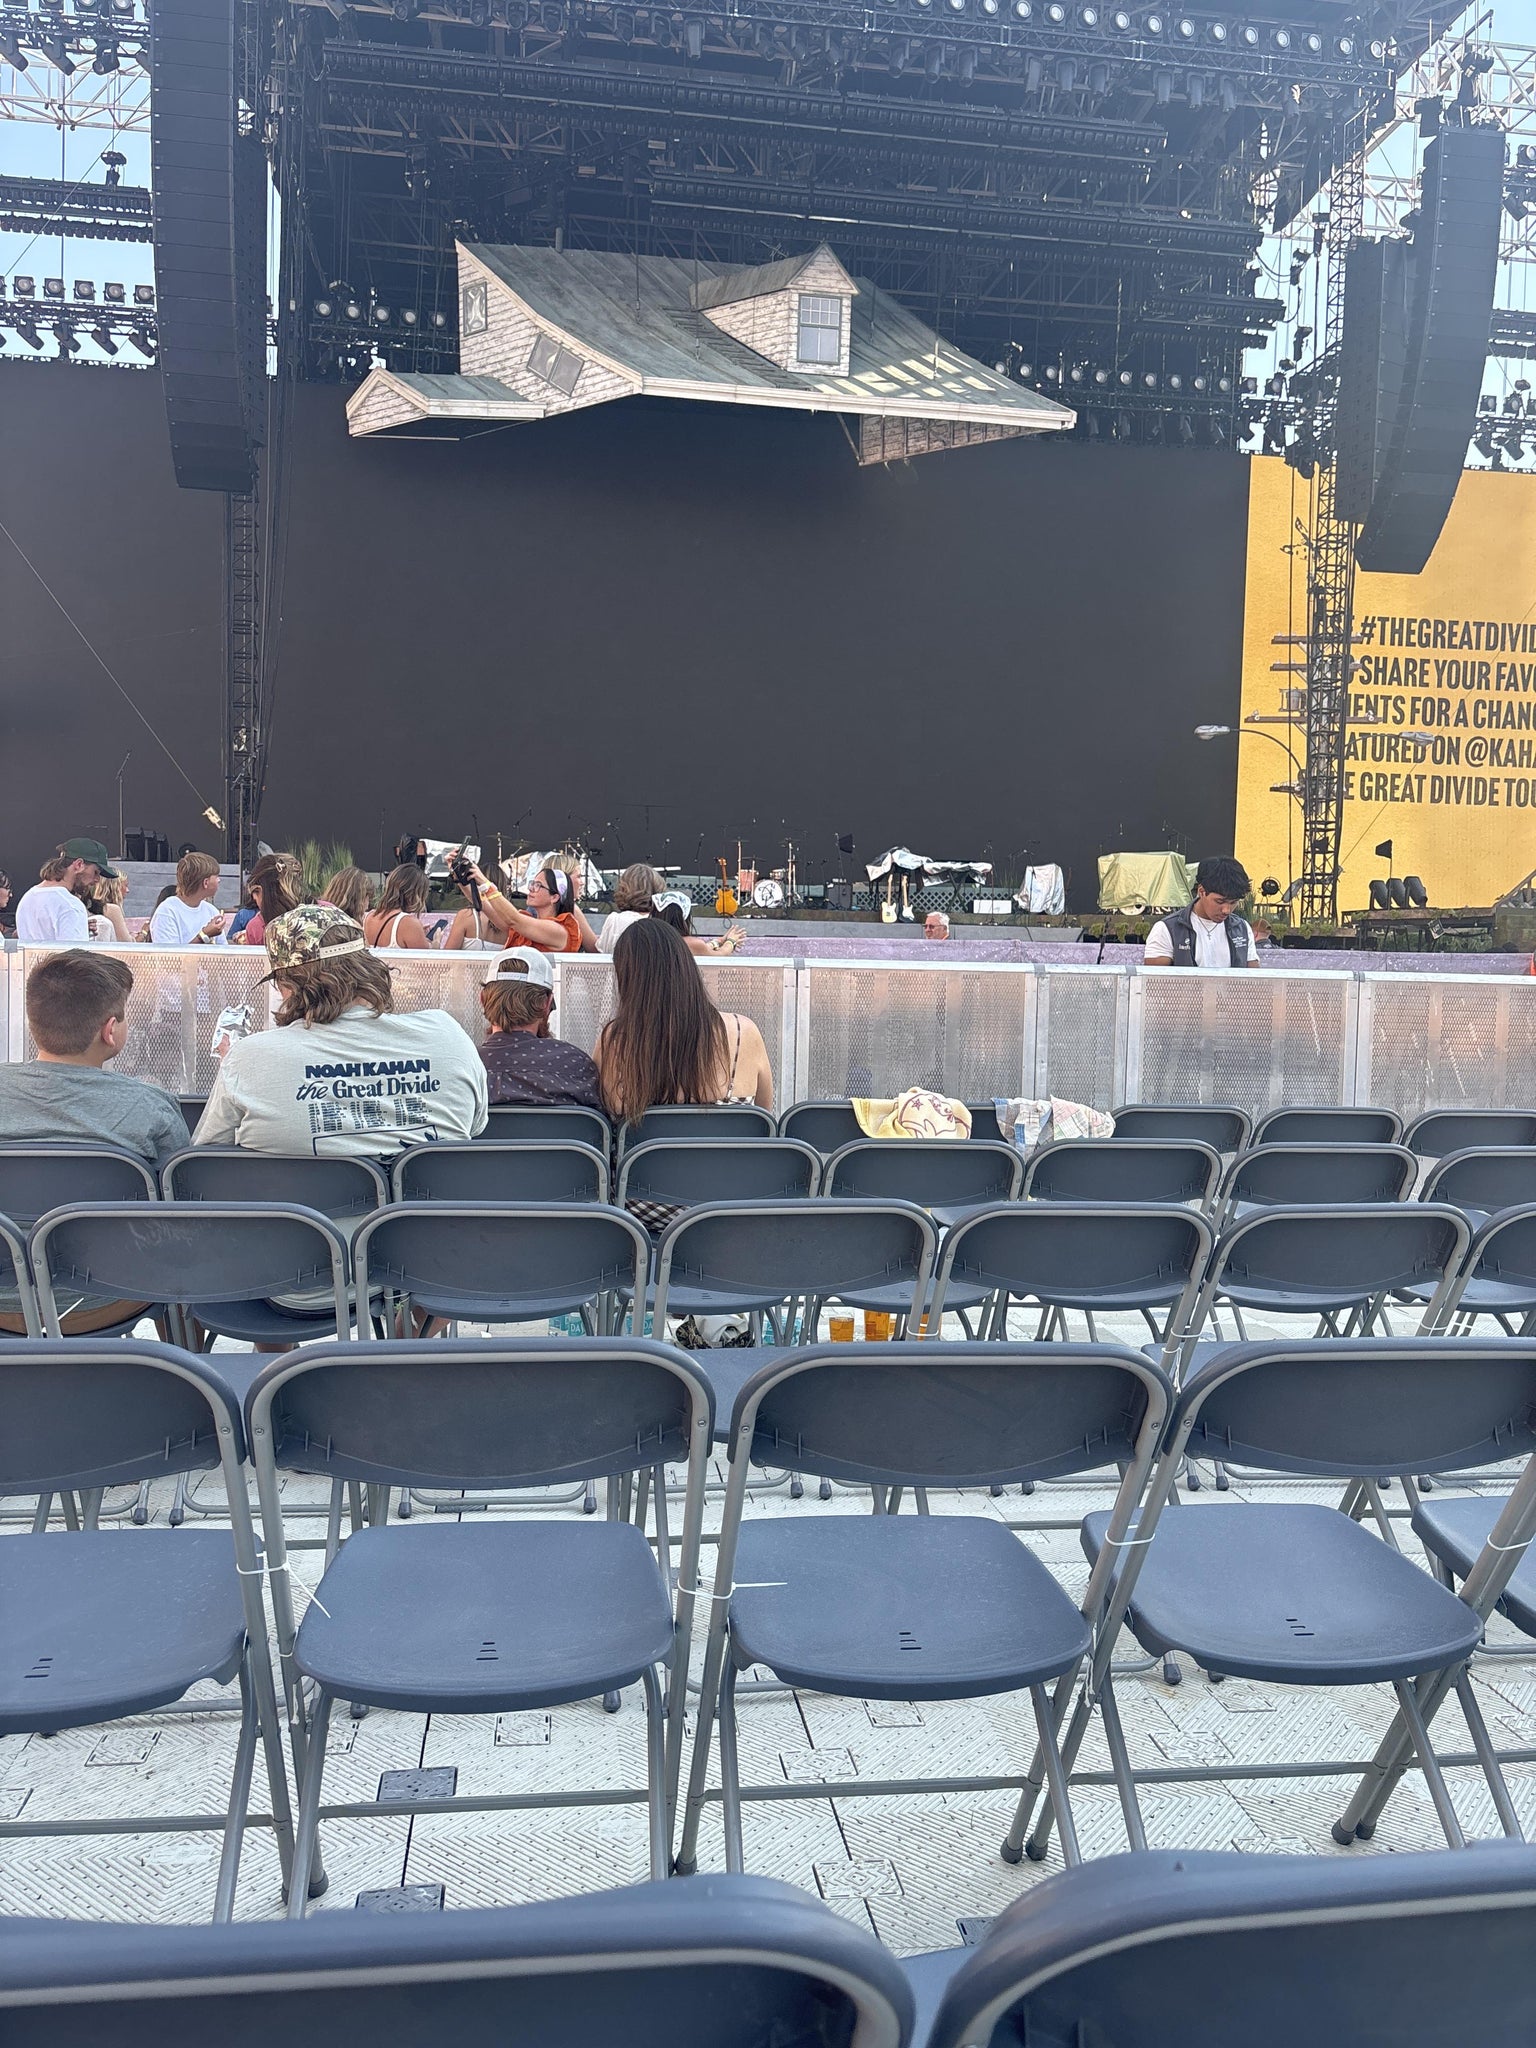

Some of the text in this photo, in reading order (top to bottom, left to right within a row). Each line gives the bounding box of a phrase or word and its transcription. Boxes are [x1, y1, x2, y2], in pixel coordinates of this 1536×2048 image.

[1359, 655, 1430, 687] SHARE
[1434, 659, 1491, 690] YOUR
[1495, 662, 1536, 692] FAV
[1345, 693, 1536, 730] ENTS FOR A CHAN
[1344, 731, 1536, 768] ATURED ON @KAH
[1360, 772, 1426, 803] GREAT
[1430, 775, 1500, 806] DIVIDE
[305, 1059, 430, 1079] NOAH KAHAN
[296, 1075, 441, 1101] the Great Divide
